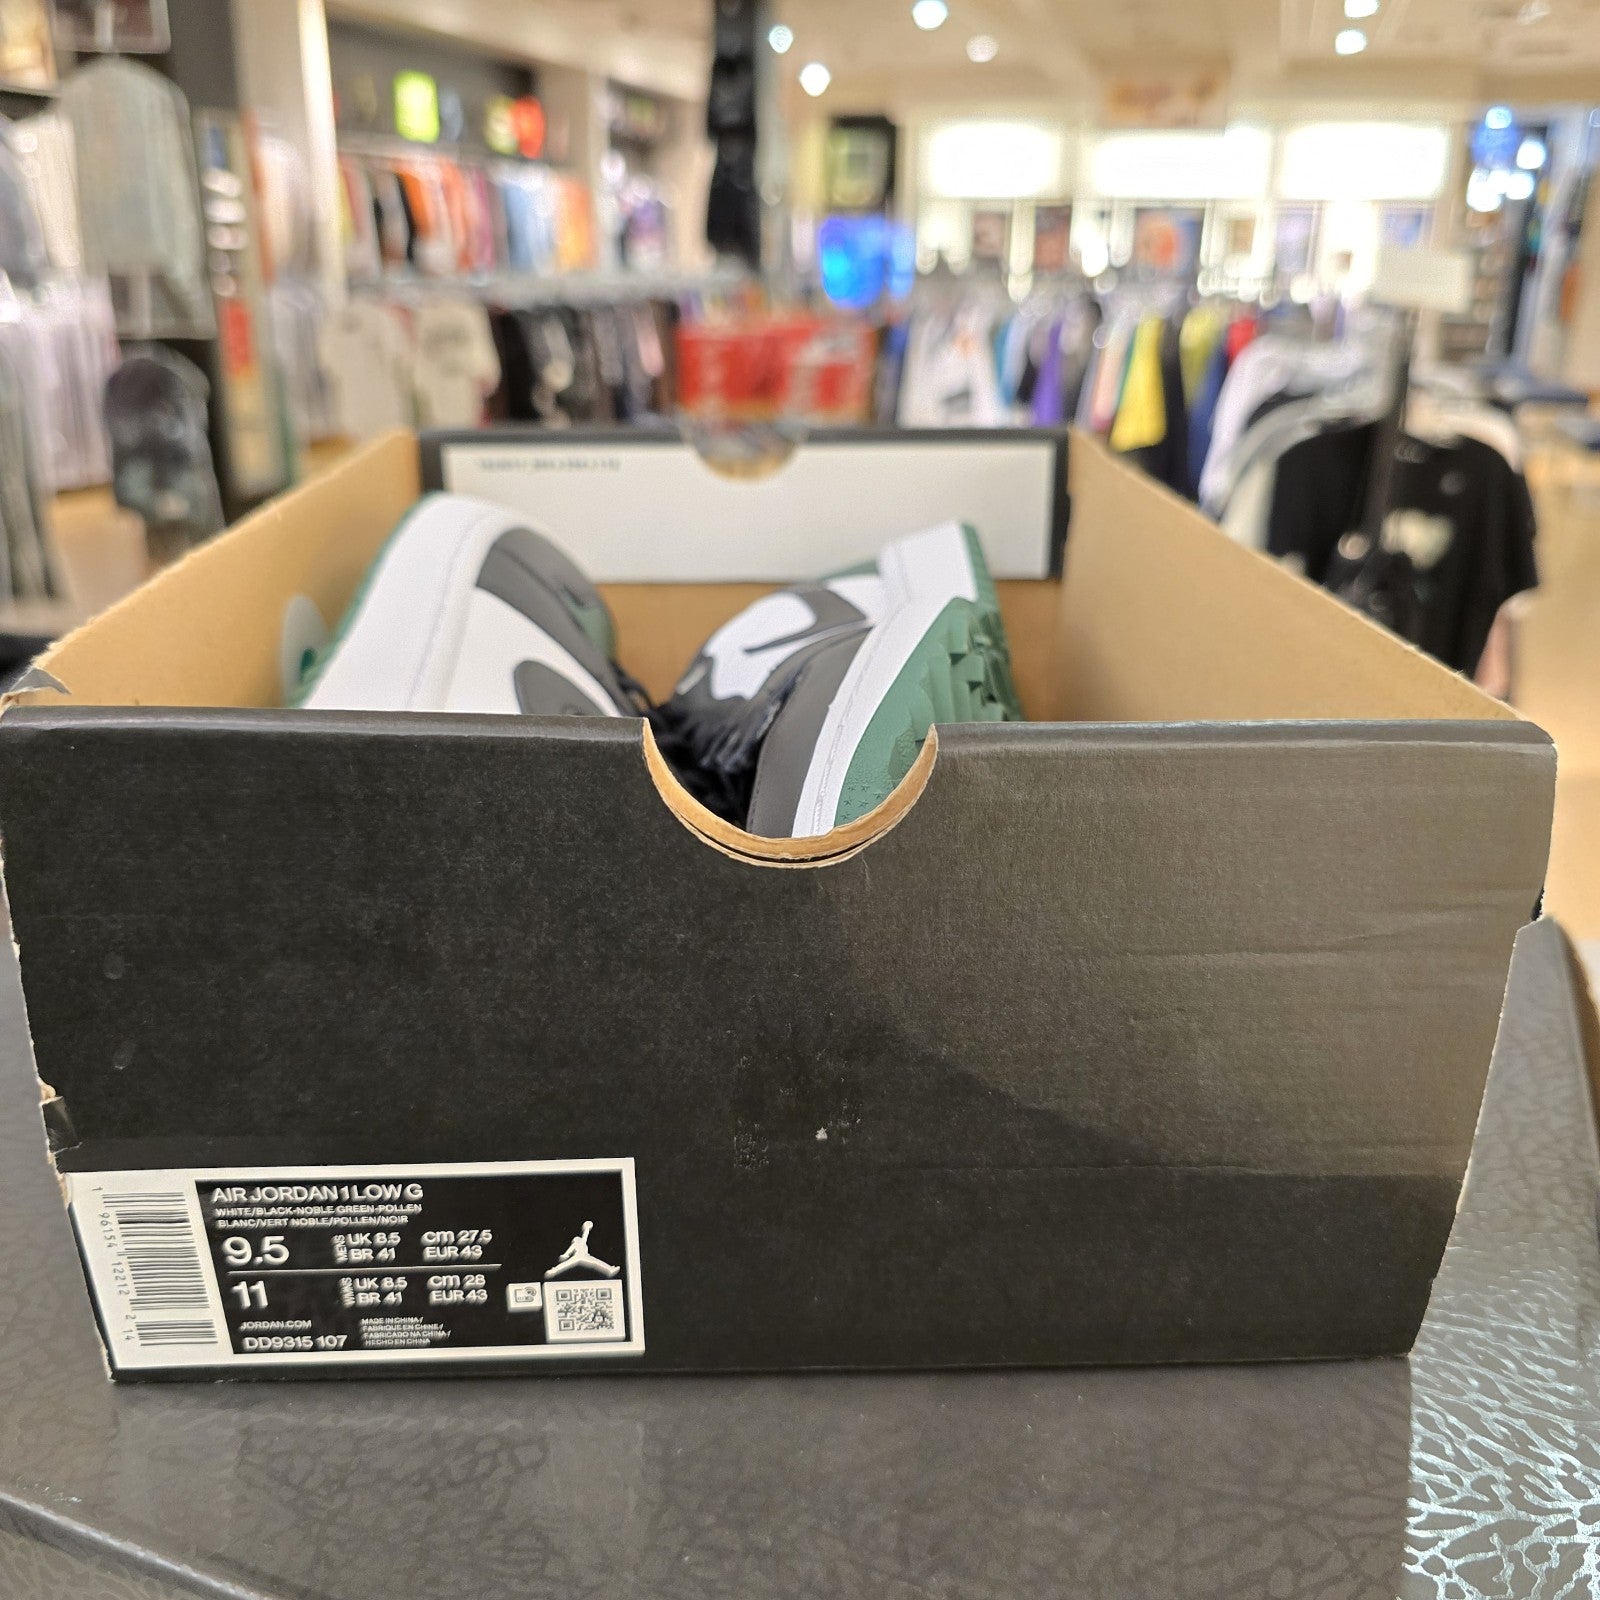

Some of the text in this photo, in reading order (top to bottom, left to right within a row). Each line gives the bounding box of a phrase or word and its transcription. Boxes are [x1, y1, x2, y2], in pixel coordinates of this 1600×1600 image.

[213, 1182, 423, 1203] AIR JORDAN 1 LOW G
[336, 1203, 422, 1215] GREEN-POLLEN
[217, 1215, 409, 1229] BLANC/VERT NOBLE/POLLEN/NOIR
[347, 1231, 401, 1246] UK 8.5
[457, 1229, 493, 1245] 27.5
[221, 1235, 289, 1266] 9.5
[350, 1247, 396, 1262] BR 41
[424, 1244, 483, 1261] EUR 43
[98, 1211, 117, 1249] 96154
[110, 1261, 130, 1296] 12212
[122, 1328, 135, 1341] 14
[354, 1276, 408, 1291] UK 8.5
[463, 1274, 486, 1289] 28
[231, 1280, 268, 1309] 11
[356, 1291, 403, 1306] BR 41
[430, 1289, 488, 1305] EUR 43
[239, 1320, 312, 1332] JORDAN.COM
[243, 1335, 348, 1351] DD9315 107
